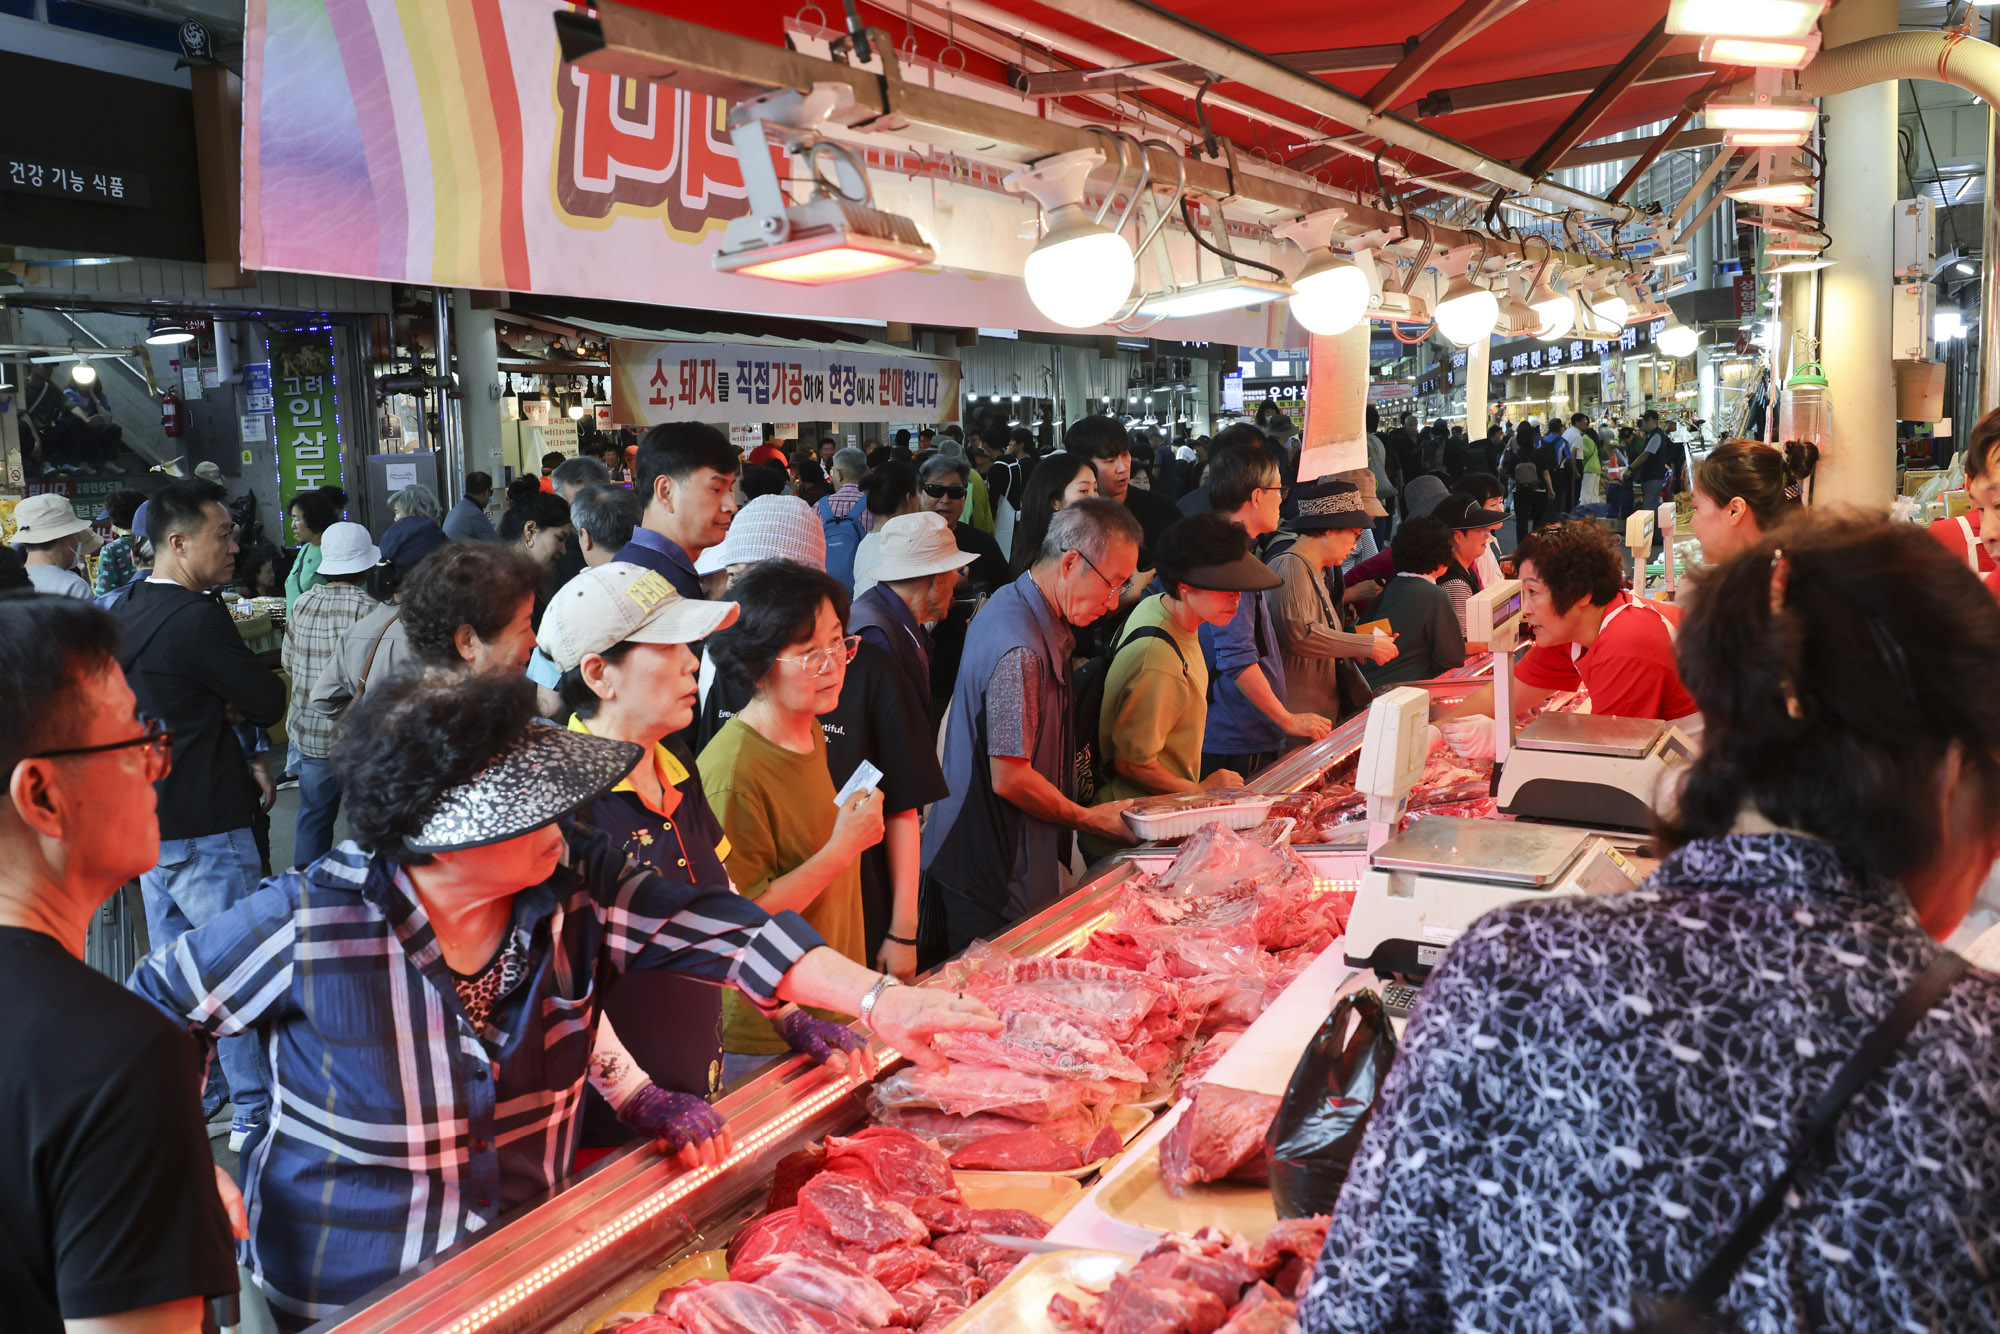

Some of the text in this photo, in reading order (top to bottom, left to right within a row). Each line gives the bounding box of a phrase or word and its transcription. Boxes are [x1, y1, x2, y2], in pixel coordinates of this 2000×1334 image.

[9, 161, 125, 198] 건강 기능 식품
[283, 375, 324, 396] 고려
[829, 363, 875, 407] 현장에서
[878, 367, 939, 408] 판매합니다
